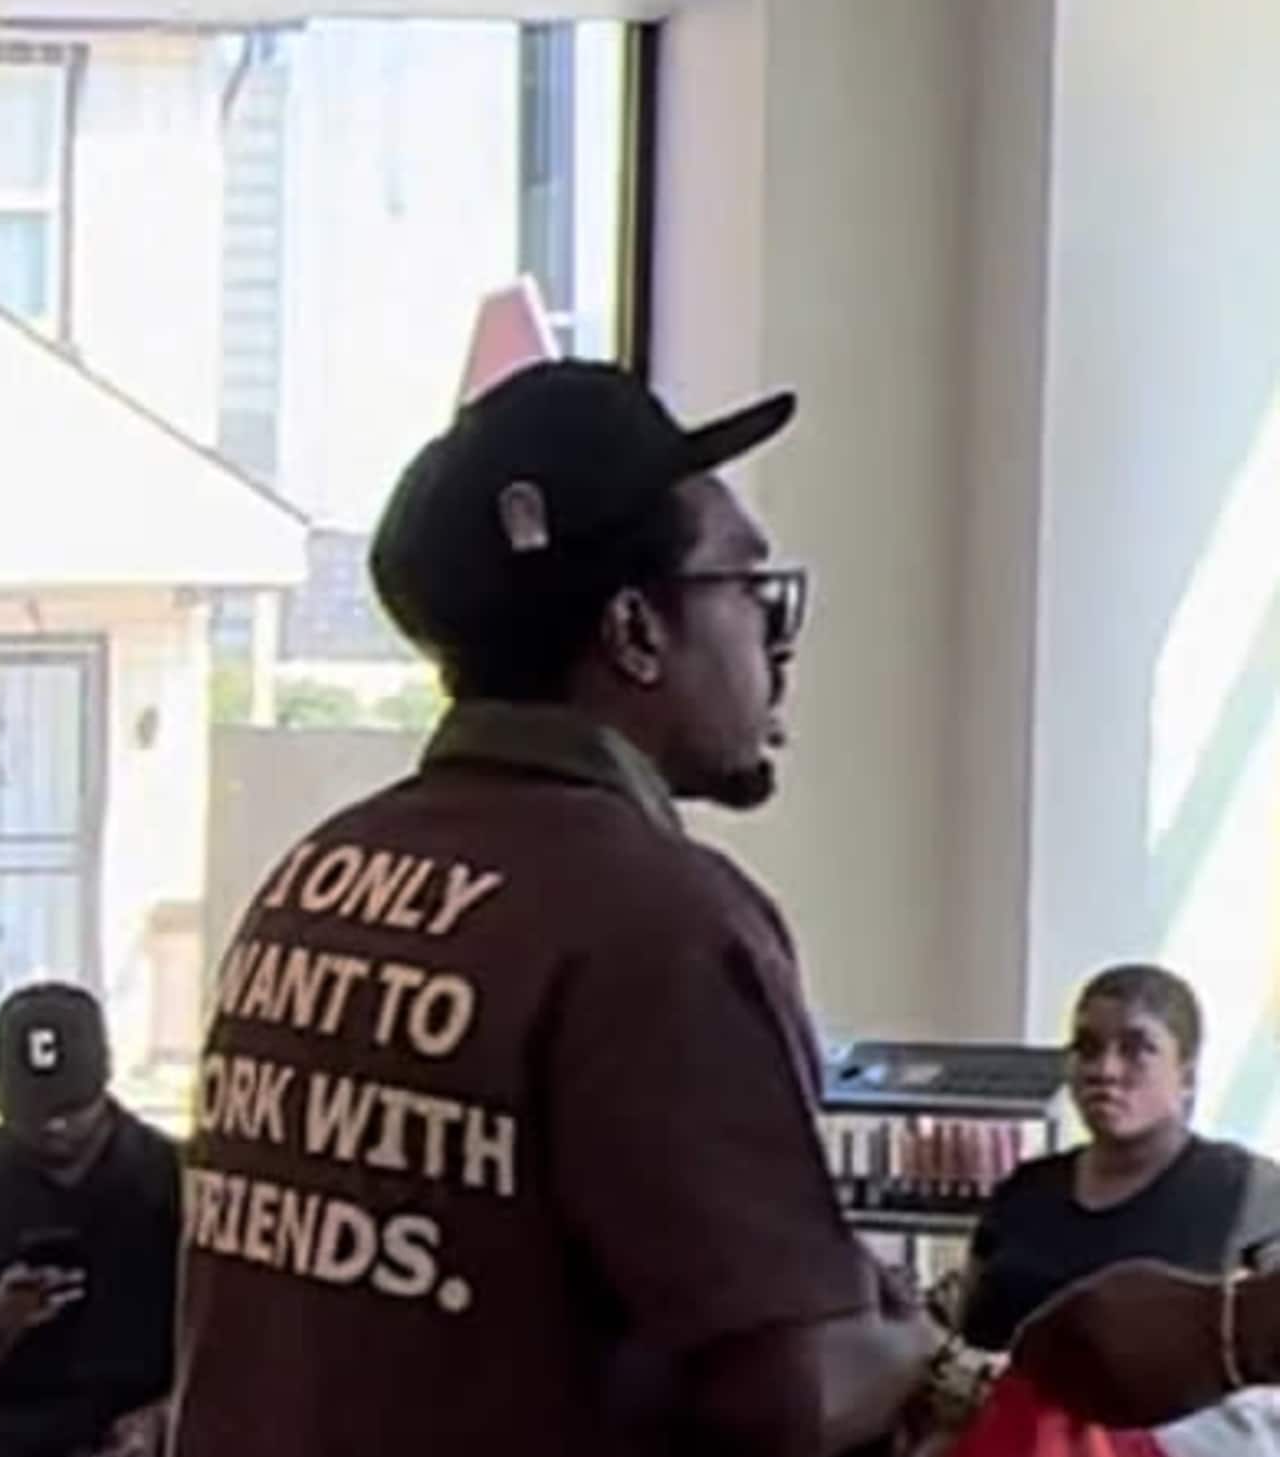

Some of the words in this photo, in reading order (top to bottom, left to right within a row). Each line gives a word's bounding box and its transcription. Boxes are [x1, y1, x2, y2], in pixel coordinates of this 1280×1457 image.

[263, 842, 316, 909] I
[299, 844, 502, 935] ONLY
[372, 958, 476, 1057] TO
[199, 1052, 296, 1144] ORK
[305, 1070, 517, 1198] WITH
